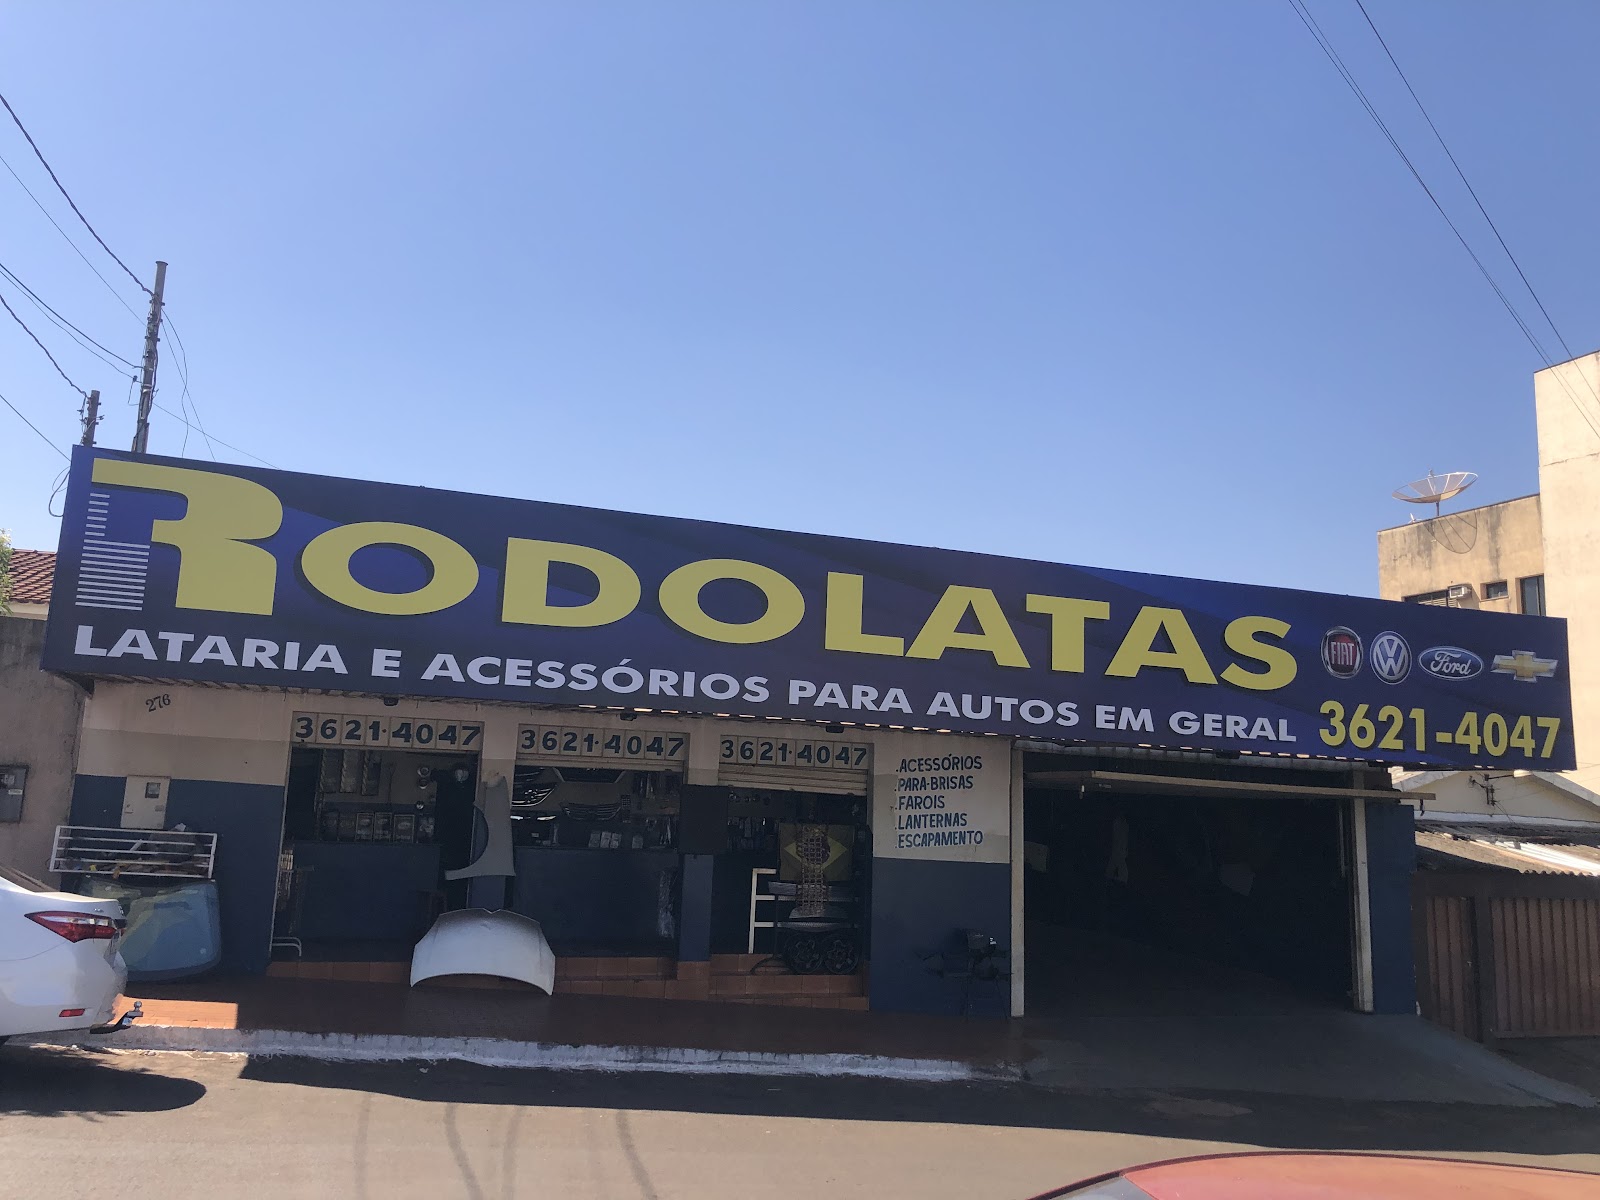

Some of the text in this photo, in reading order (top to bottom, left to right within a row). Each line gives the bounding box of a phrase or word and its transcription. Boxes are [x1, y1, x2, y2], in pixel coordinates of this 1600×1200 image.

[90, 457, 1299, 691] RODOLATAS
[1330, 641, 1355, 666] FIAT
[1430, 650, 1472, 675] Ford
[74, 624, 1297, 742] LATARIA E ACESSÓRIOS PARA AUTOS EM GERAL
[145, 693, 171, 712] 276
[1319, 700, 1561, 759] 3621-4047
